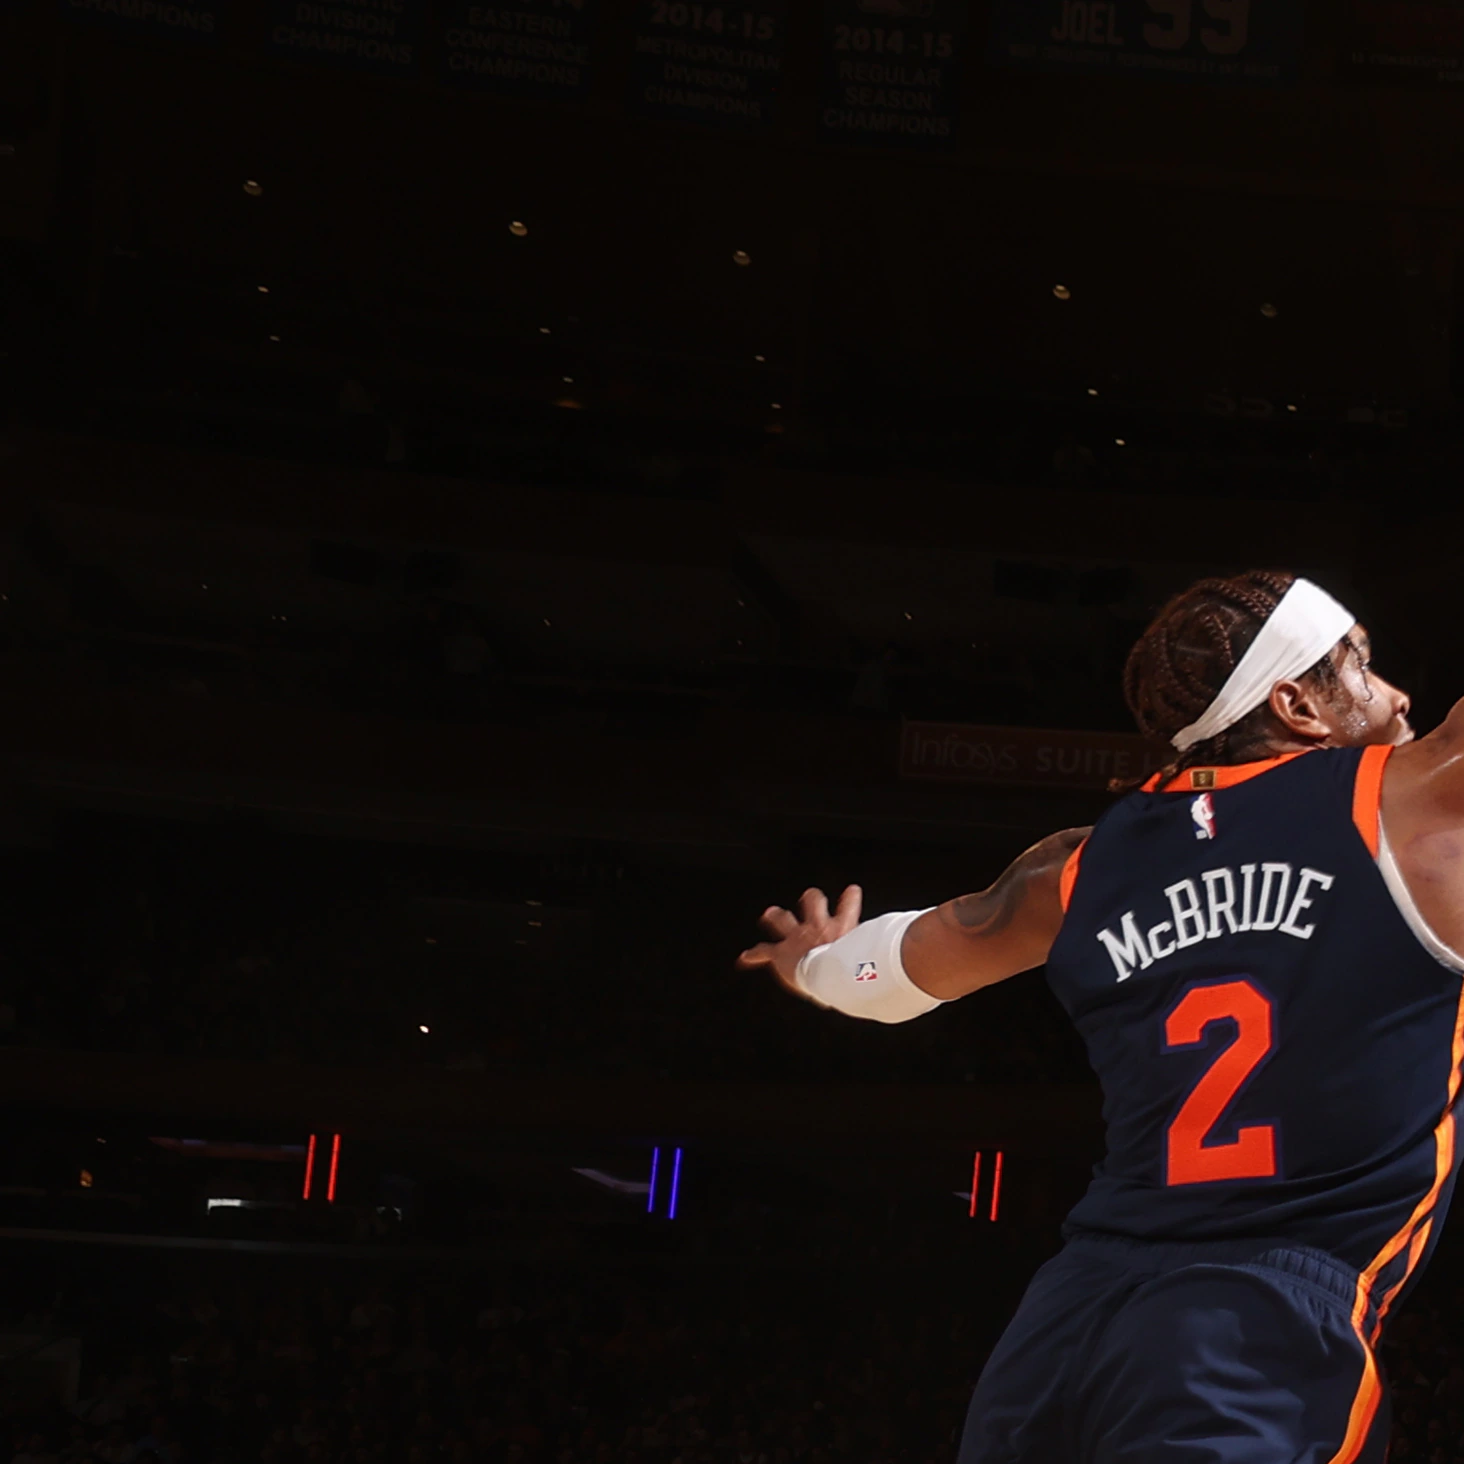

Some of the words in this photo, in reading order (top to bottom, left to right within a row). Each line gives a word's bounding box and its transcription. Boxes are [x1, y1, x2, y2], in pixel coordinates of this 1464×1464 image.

[467, 6, 572, 37] EASTERN
[271, 25, 414, 65] CHAMPIONS
[444, 28, 591, 65] CONFERENCE
[448, 52, 581, 87] CHAMPIONS
[838, 61, 943, 88] REGULAR
[643, 85, 762, 119] CHAMPIONS
[844, 86, 934, 112] SEASON
[822, 108, 951, 138] CHAMPIONS
[1035, 746, 1131, 777] SUITE
[1096, 862, 1335, 982] McBRIDE
[1163, 976, 1280, 1188] 2
